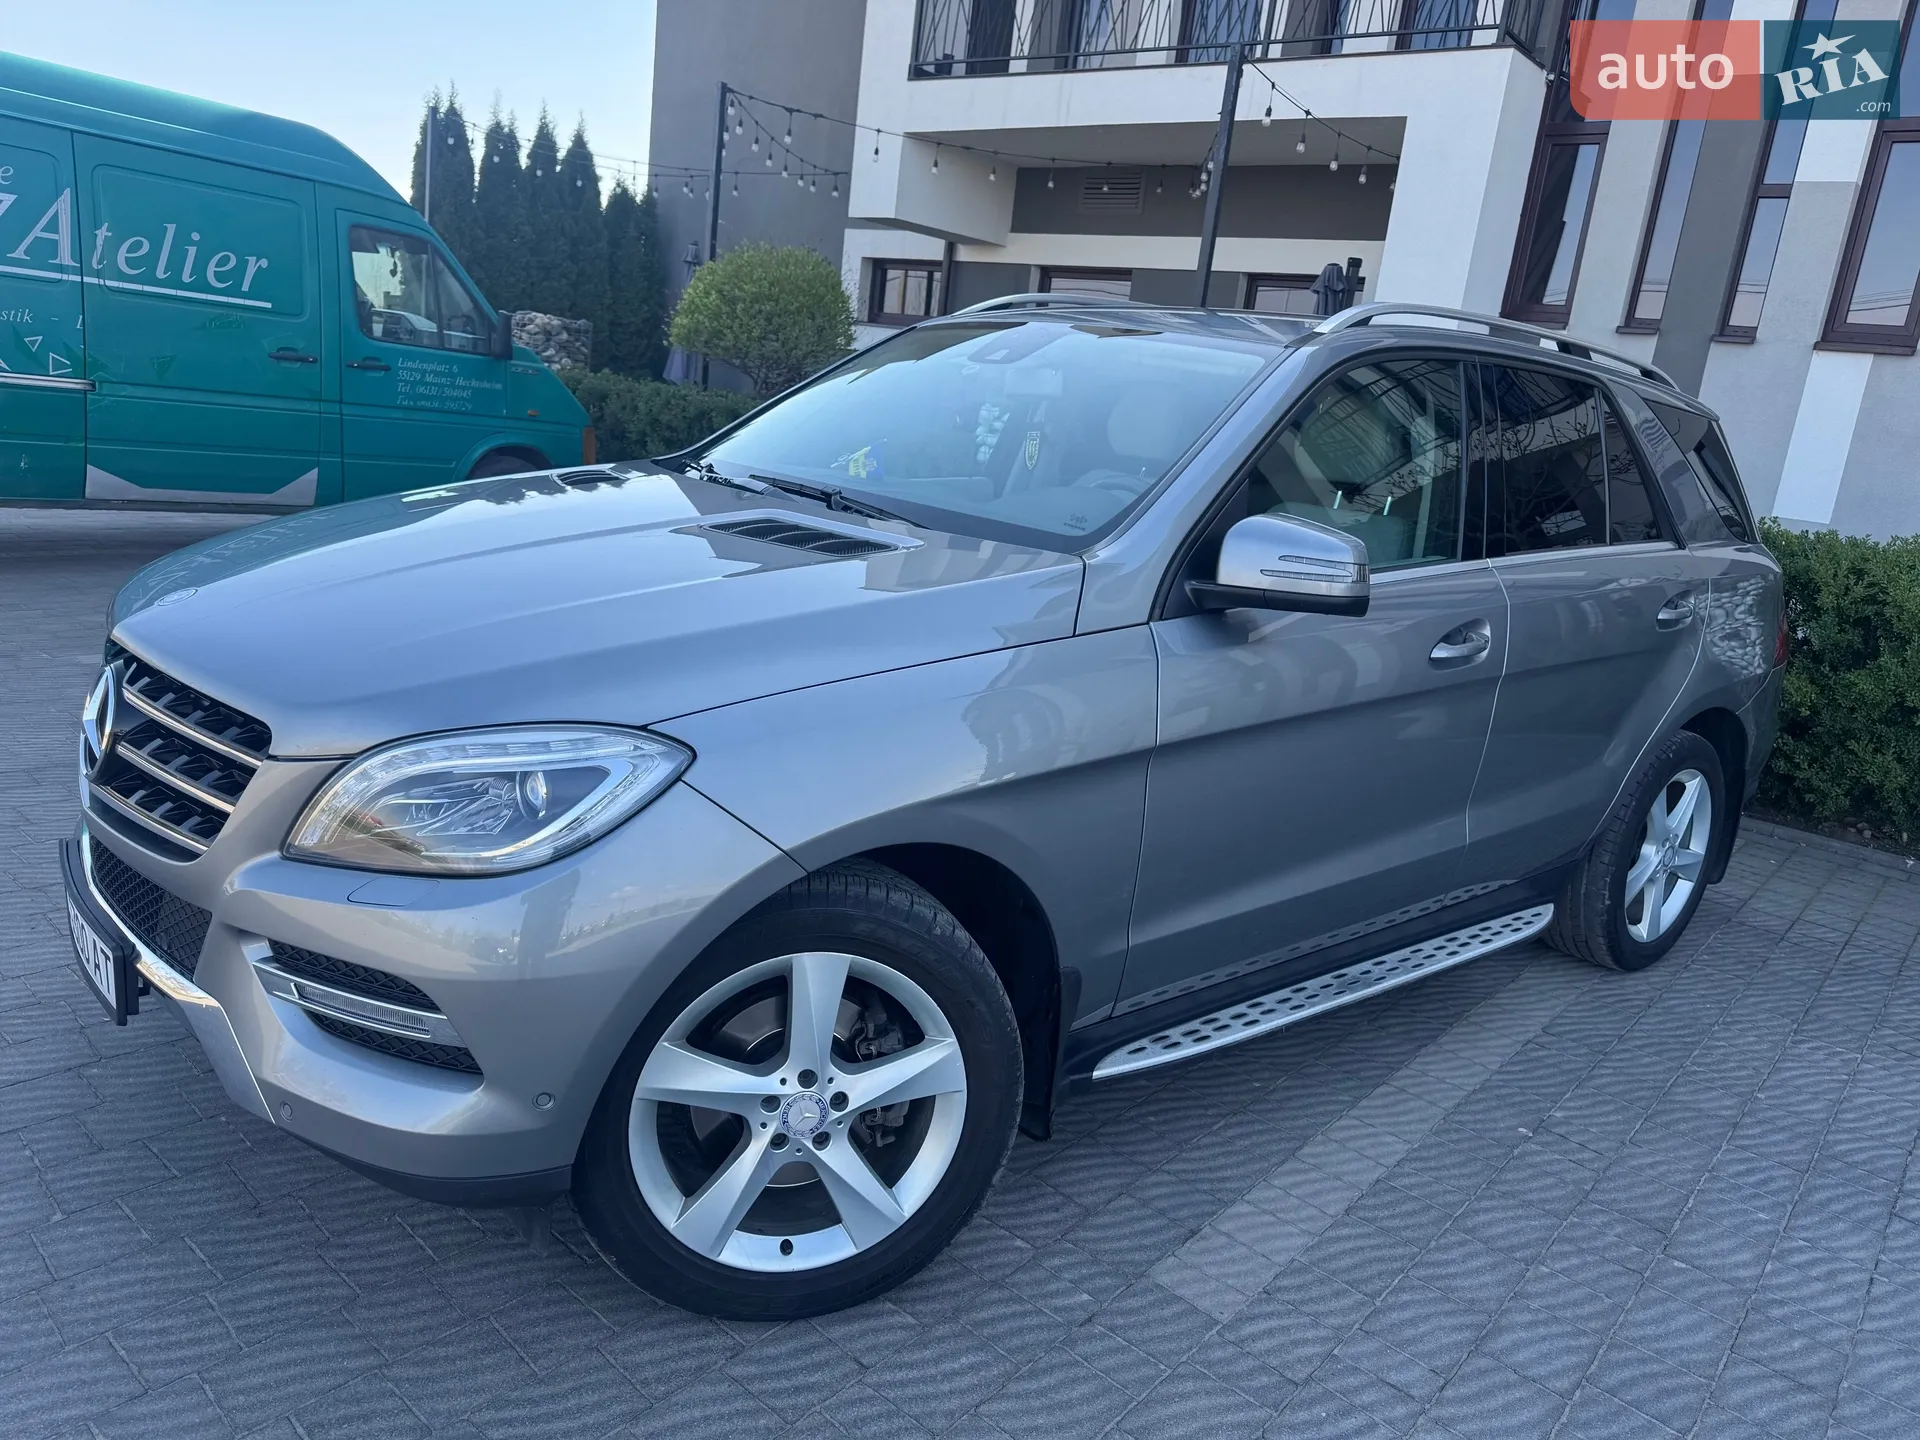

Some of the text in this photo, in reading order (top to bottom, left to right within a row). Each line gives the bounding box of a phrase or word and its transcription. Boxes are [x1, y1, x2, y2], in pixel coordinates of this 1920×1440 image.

[398, 357, 459, 374] Lindenplatz 6
[397, 370, 421, 381] 55129
[92, 936, 113, 996] AT
